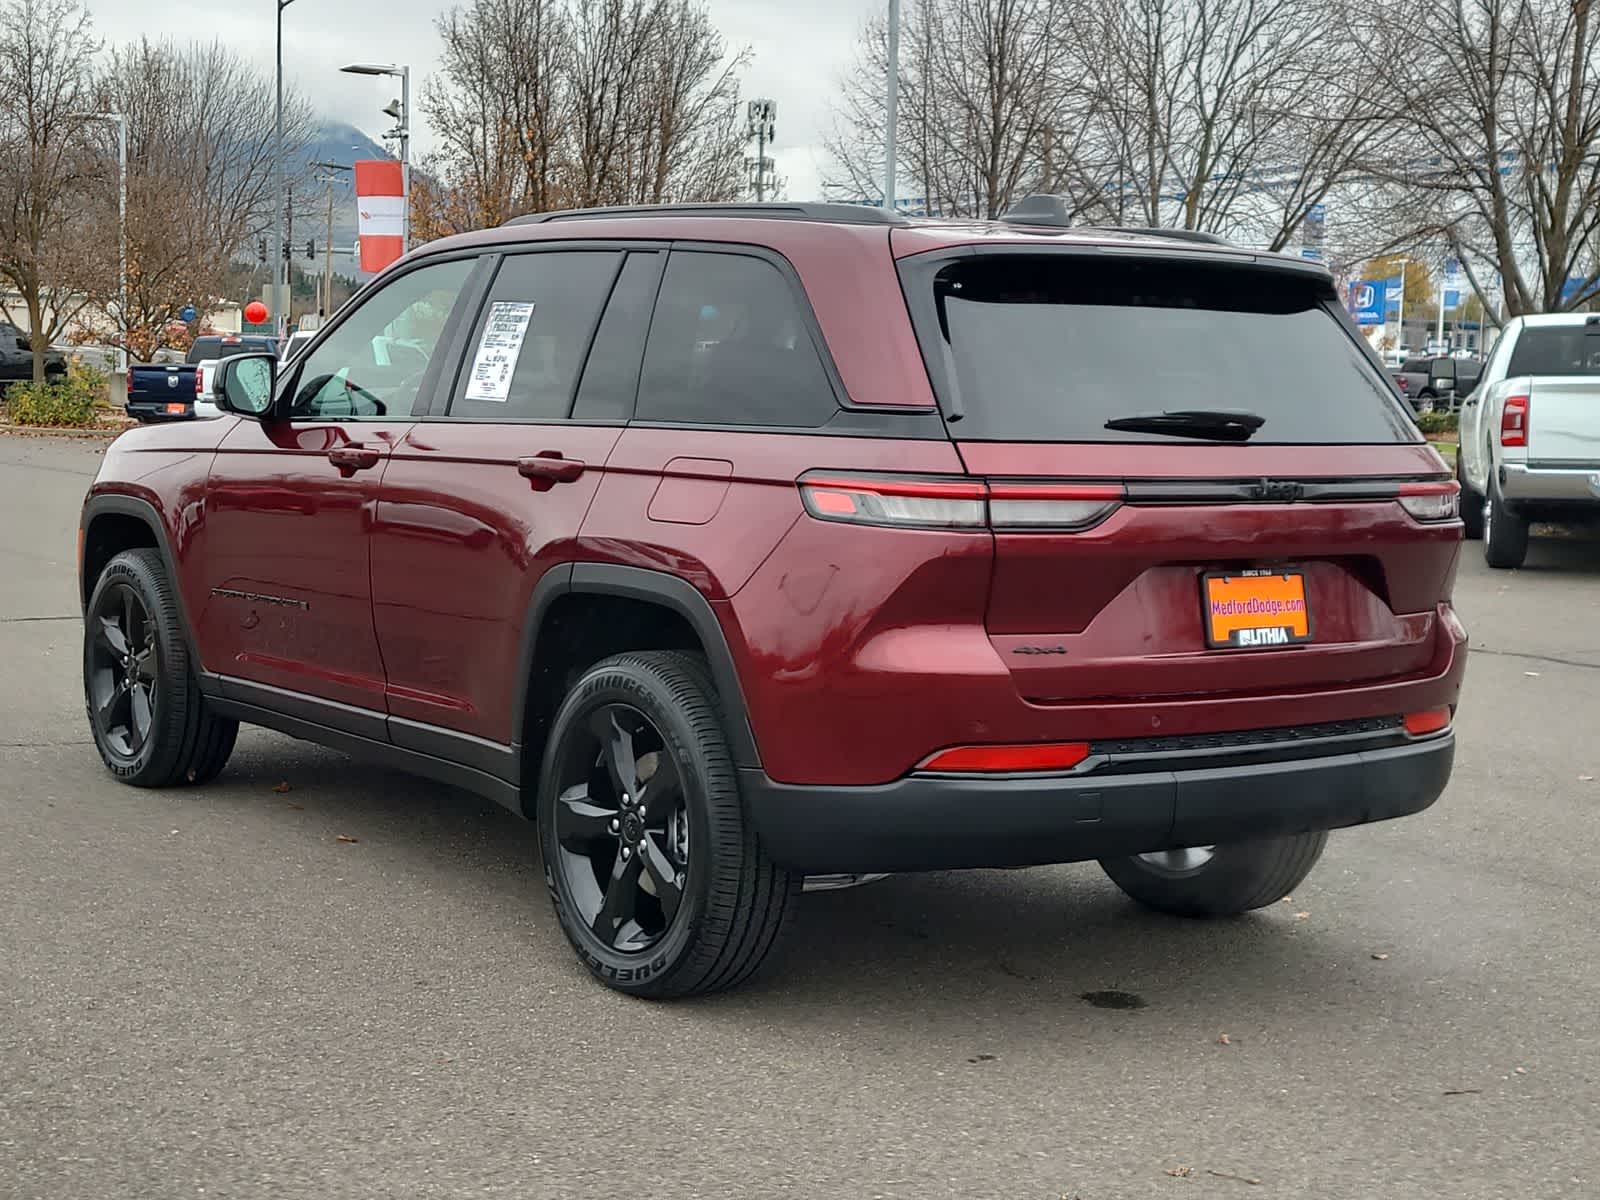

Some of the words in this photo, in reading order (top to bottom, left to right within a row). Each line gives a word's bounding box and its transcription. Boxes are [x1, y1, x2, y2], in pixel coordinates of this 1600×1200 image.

[1252, 477, 1302, 501] Jeep
[1211, 598, 1305, 616] MedfordDodge.com
[1250, 627, 1288, 645] LITHIA
